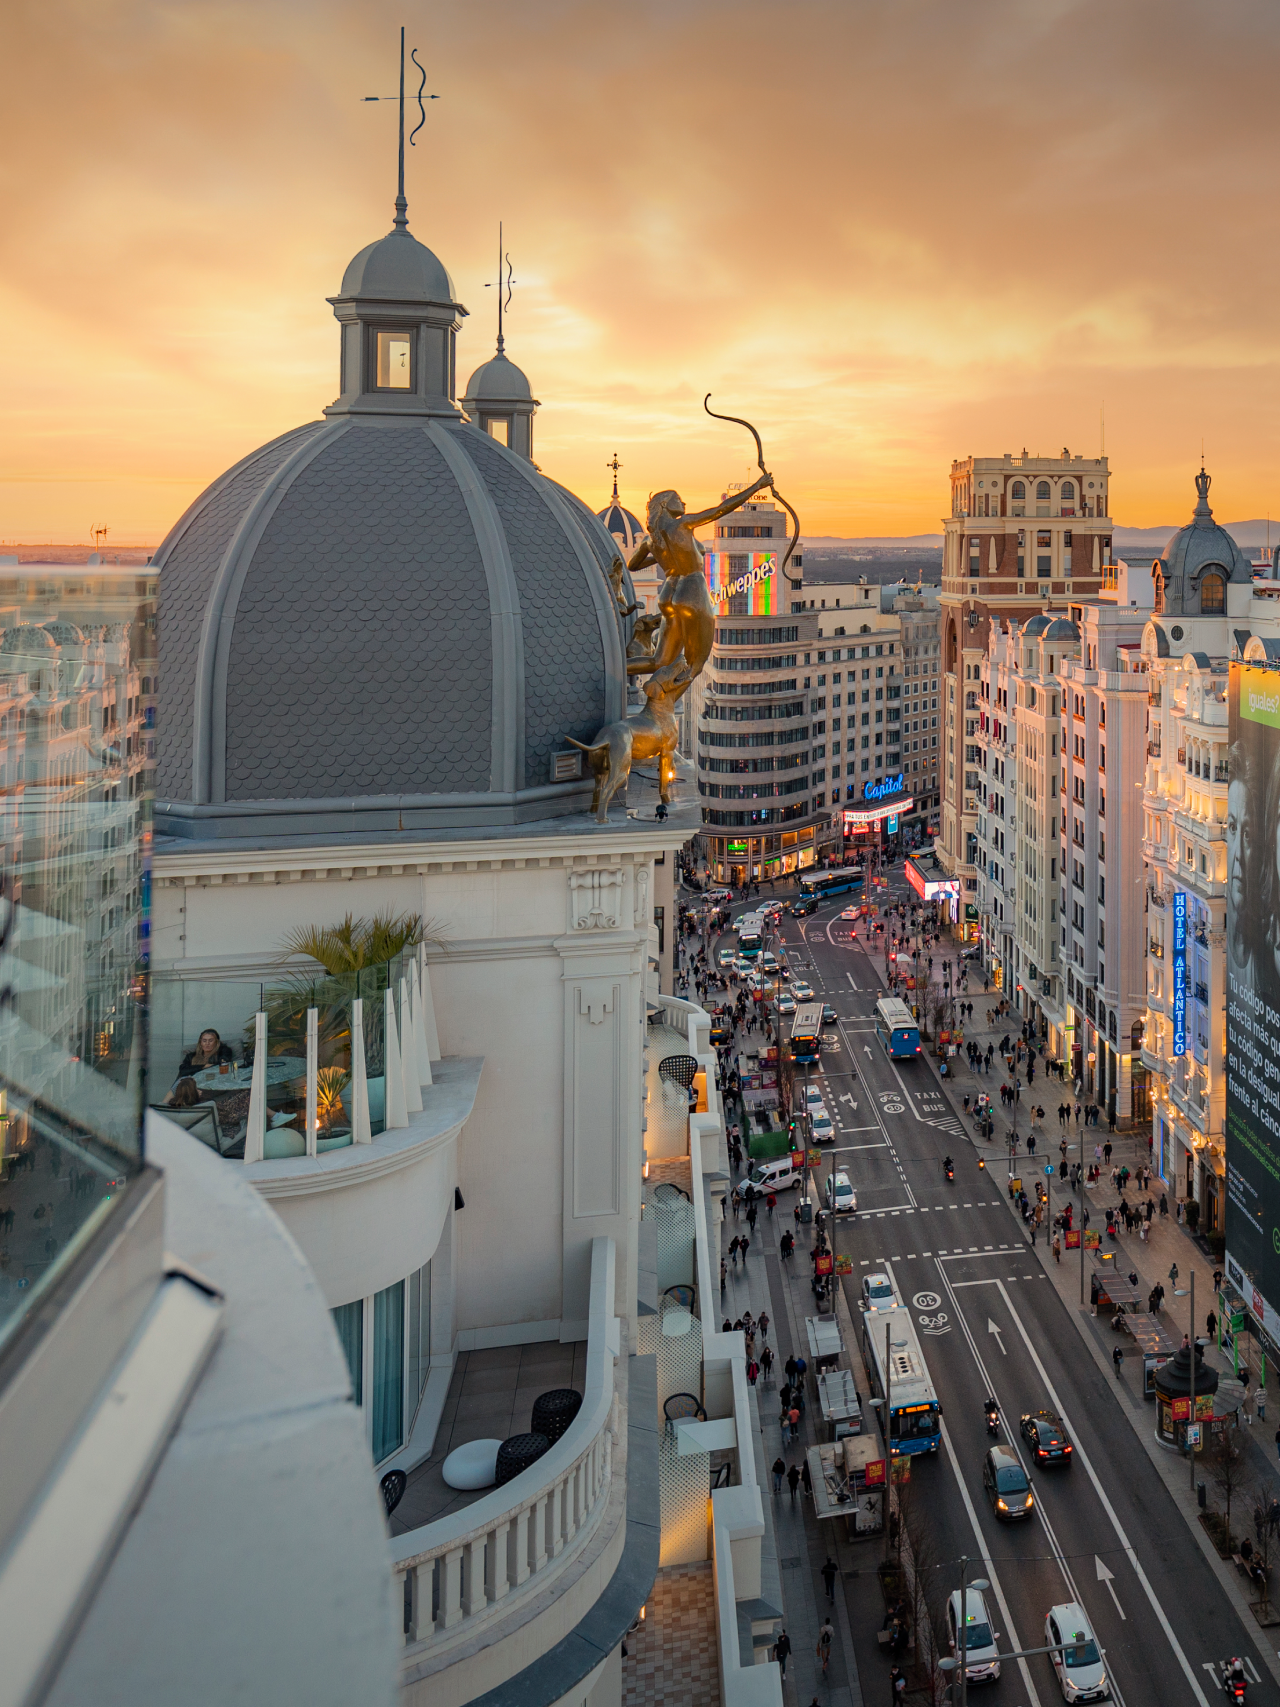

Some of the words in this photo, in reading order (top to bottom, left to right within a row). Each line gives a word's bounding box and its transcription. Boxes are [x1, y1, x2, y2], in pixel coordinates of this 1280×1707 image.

[710, 557, 776, 608] Schweppes
[1249, 688, 1280, 714] iguales?
[864, 773, 903, 800] Capitol
[1175, 895, 1185, 949] HOTEL
[1175, 957, 1185, 1054] ATLANTICO
[1229, 972, 1238, 994] Tu
[1239, 984, 1265, 1016] código
[1229, 1001, 1251, 1031] afecta
[1253, 1021, 1269, 1046] más
[1229, 1023, 1236, 1044] tu
[1238, 1035, 1263, 1067] código
[1228, 1053, 1237, 1071] en
[1239, 1057, 1246, 1079] la
[1228, 1073, 1250, 1108] frente
[1251, 1098, 1259, 1117] al
